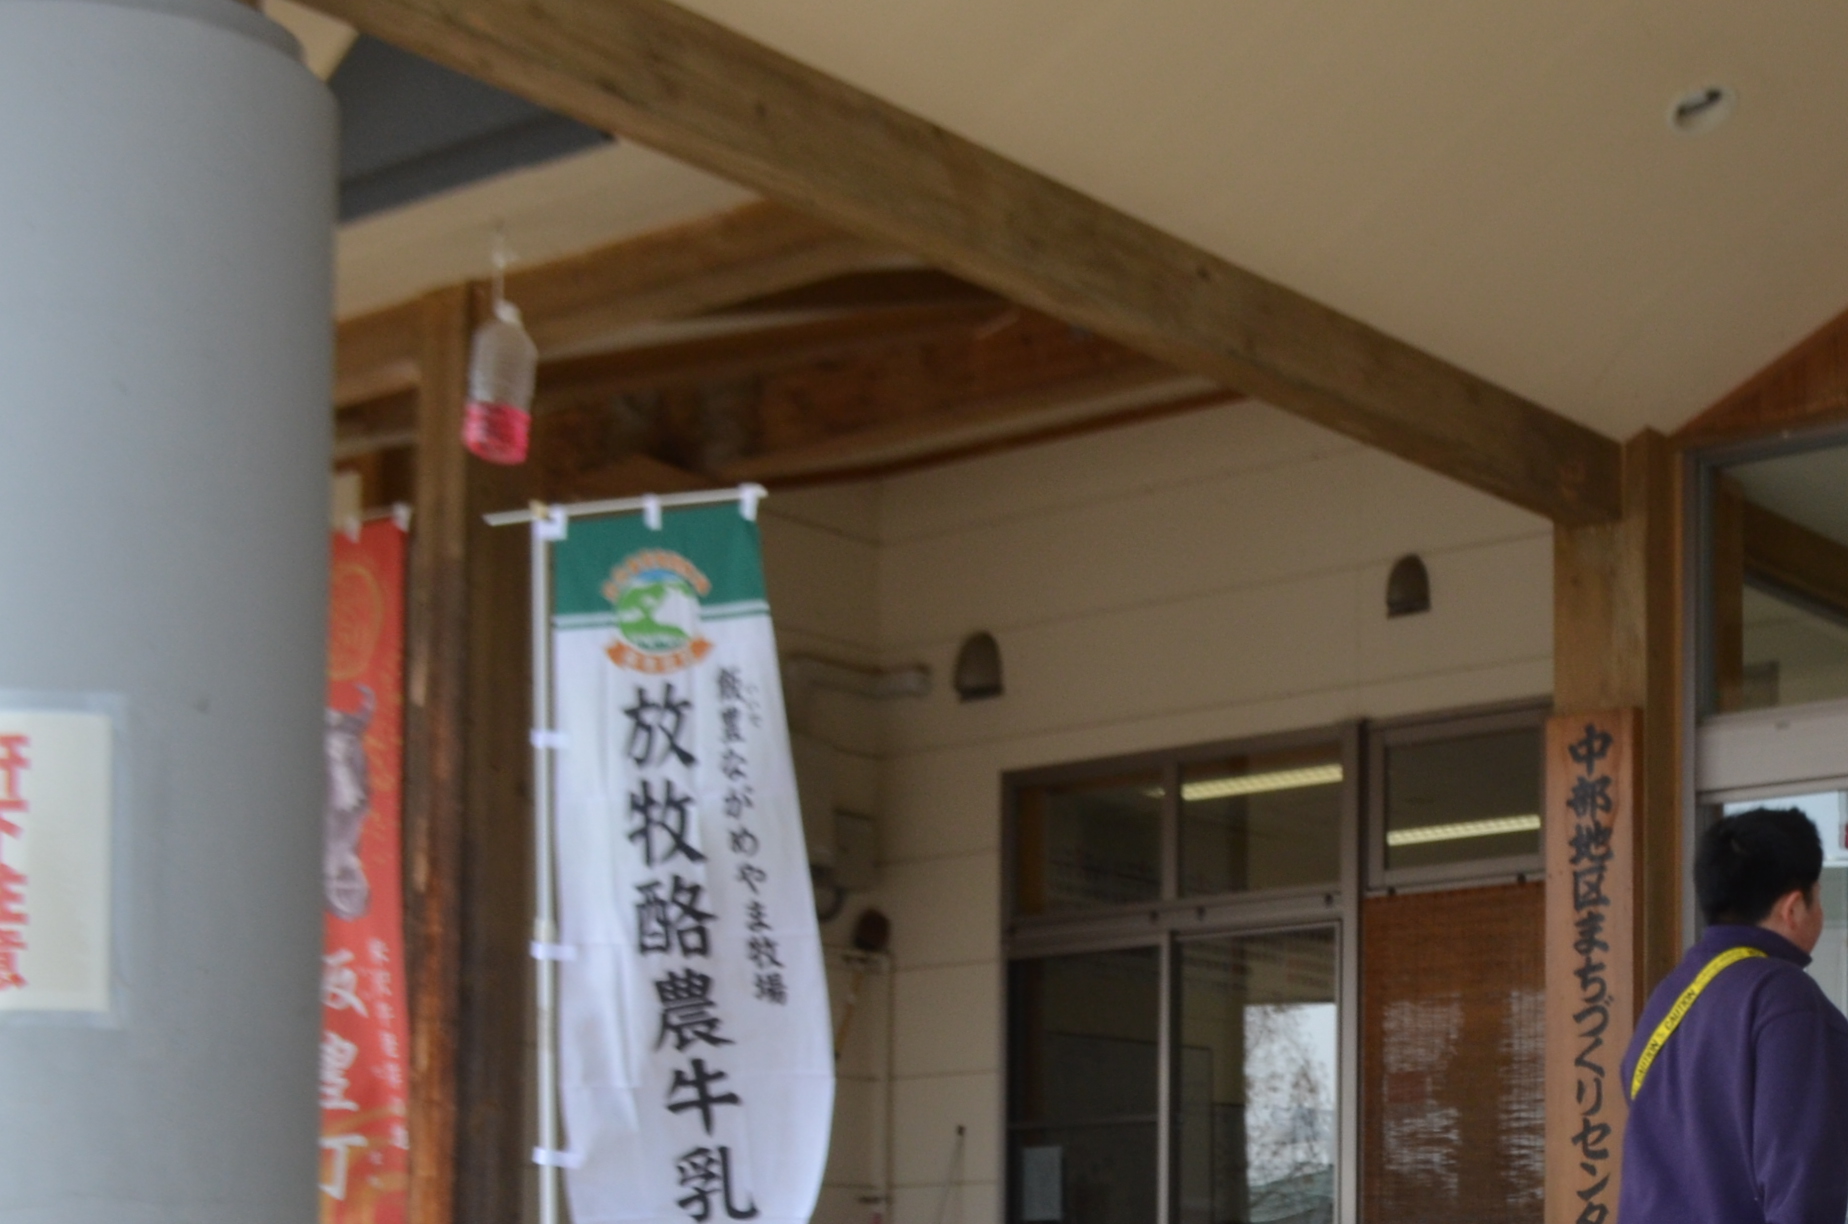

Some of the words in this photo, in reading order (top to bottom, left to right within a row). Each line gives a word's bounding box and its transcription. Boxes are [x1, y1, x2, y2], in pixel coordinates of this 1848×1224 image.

[623, 682, 761, 1224] 放牧酪農牛乳
[1665, 989, 1697, 1031] CAUTION
